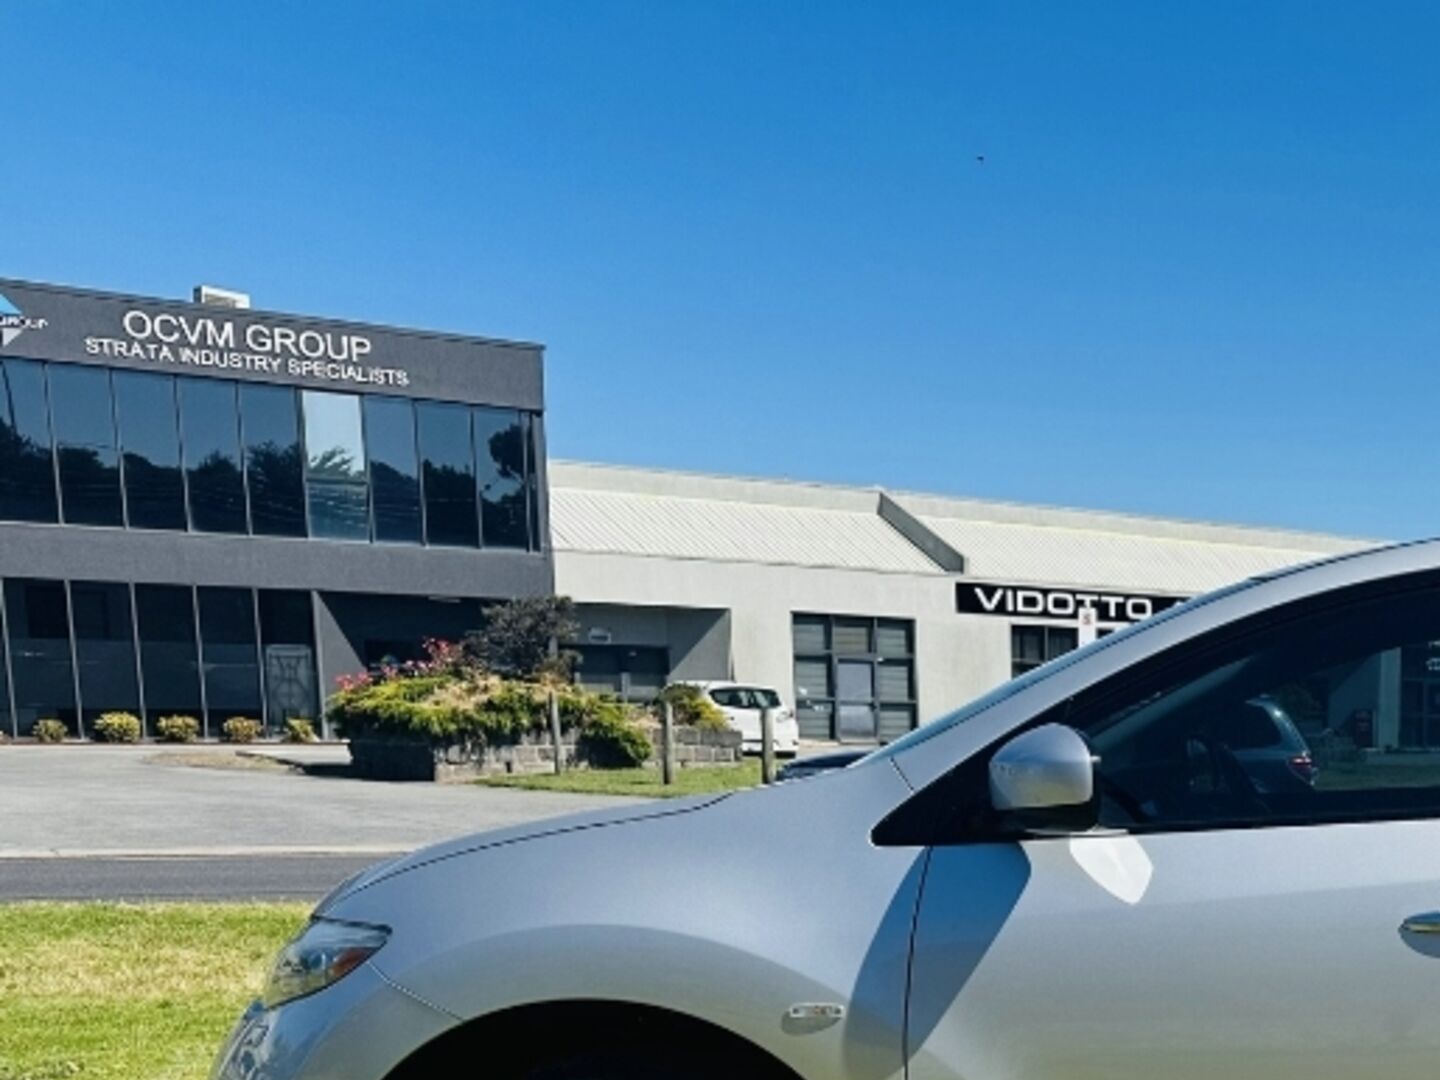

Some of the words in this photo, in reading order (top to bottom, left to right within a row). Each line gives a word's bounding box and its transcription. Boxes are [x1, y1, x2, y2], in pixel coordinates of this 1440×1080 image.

[122, 310, 234, 348] OCVM
[246, 324, 372, 362] GROUP
[84, 337, 174, 362] STRATA
[179, 346, 281, 372] INDUSTRY
[288, 359, 410, 387] SPECIALISTS
[974, 587, 1153, 620] VIDOTTO
